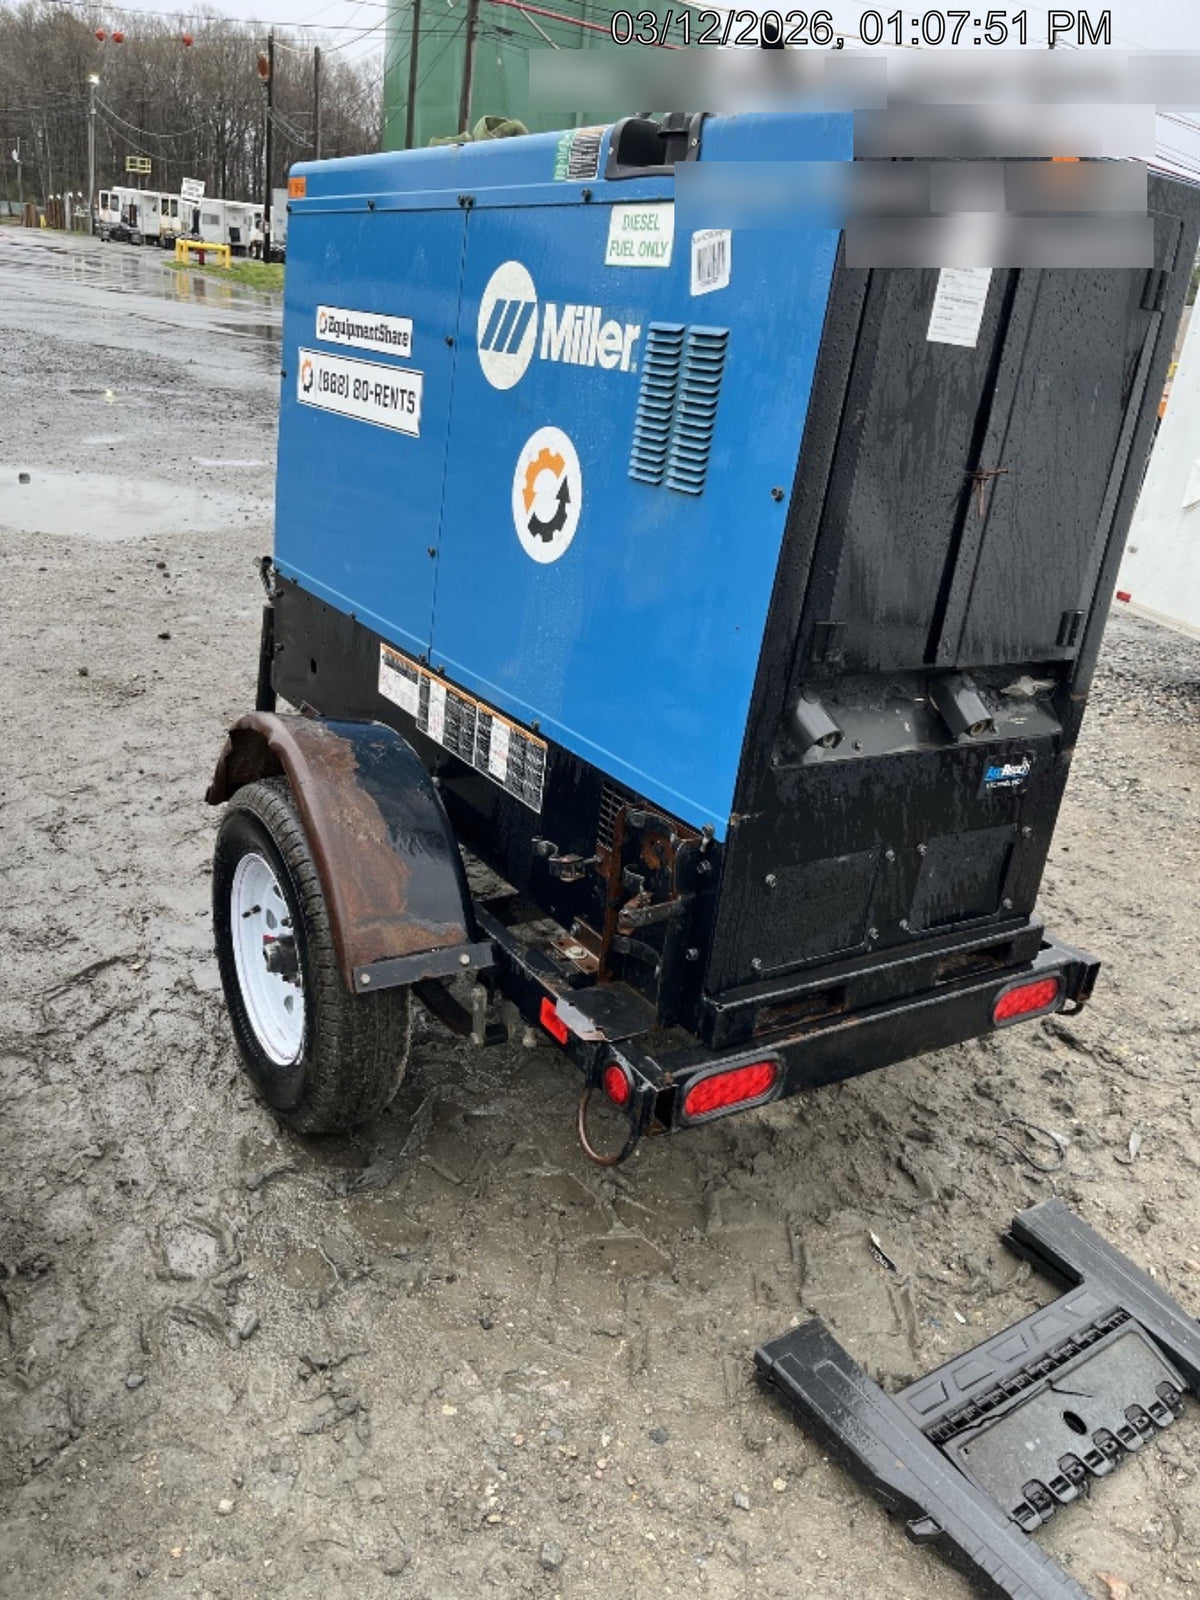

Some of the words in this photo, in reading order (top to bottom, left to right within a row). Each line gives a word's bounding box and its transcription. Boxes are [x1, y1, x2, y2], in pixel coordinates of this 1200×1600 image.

[622, 213, 660, 231] DIESEL
[609, 239, 635, 257] FUEL
[638, 240, 669, 258] ONLY
[328, 315, 409, 347] EquipmentShare
[539, 303, 641, 372] Miller
[318, 368, 350, 399] (888)
[352, 378, 416, 414] 80-RENTS
